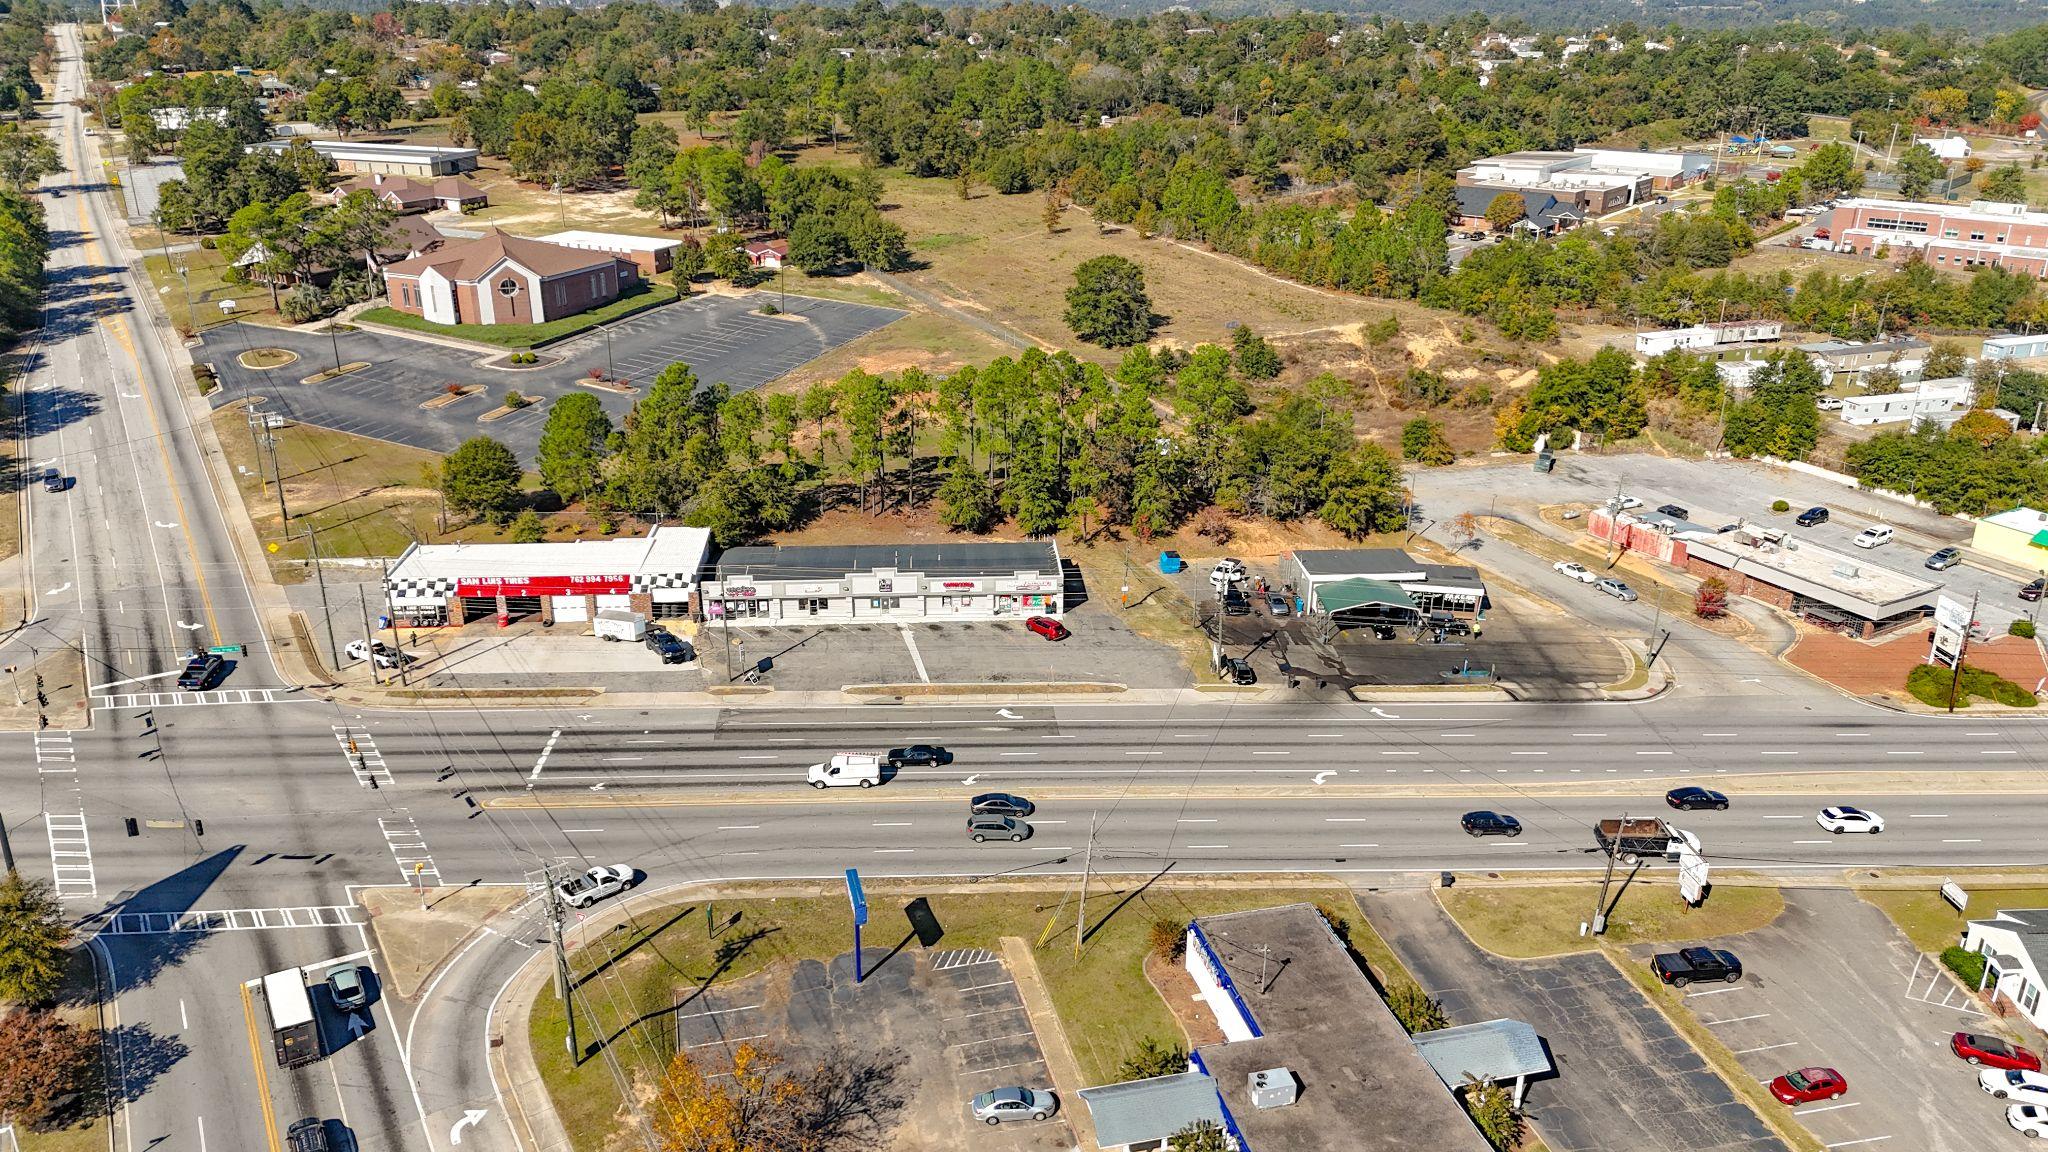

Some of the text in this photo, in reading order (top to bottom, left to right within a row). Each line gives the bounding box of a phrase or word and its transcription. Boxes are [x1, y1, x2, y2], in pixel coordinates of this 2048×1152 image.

[461, 577, 530, 585] SAN LUIS TIRES
[570, 575, 584, 583] 762
[585, 575, 601, 583] 994
[521, 589, 527, 597] 2
[565, 588, 571, 596] 3
